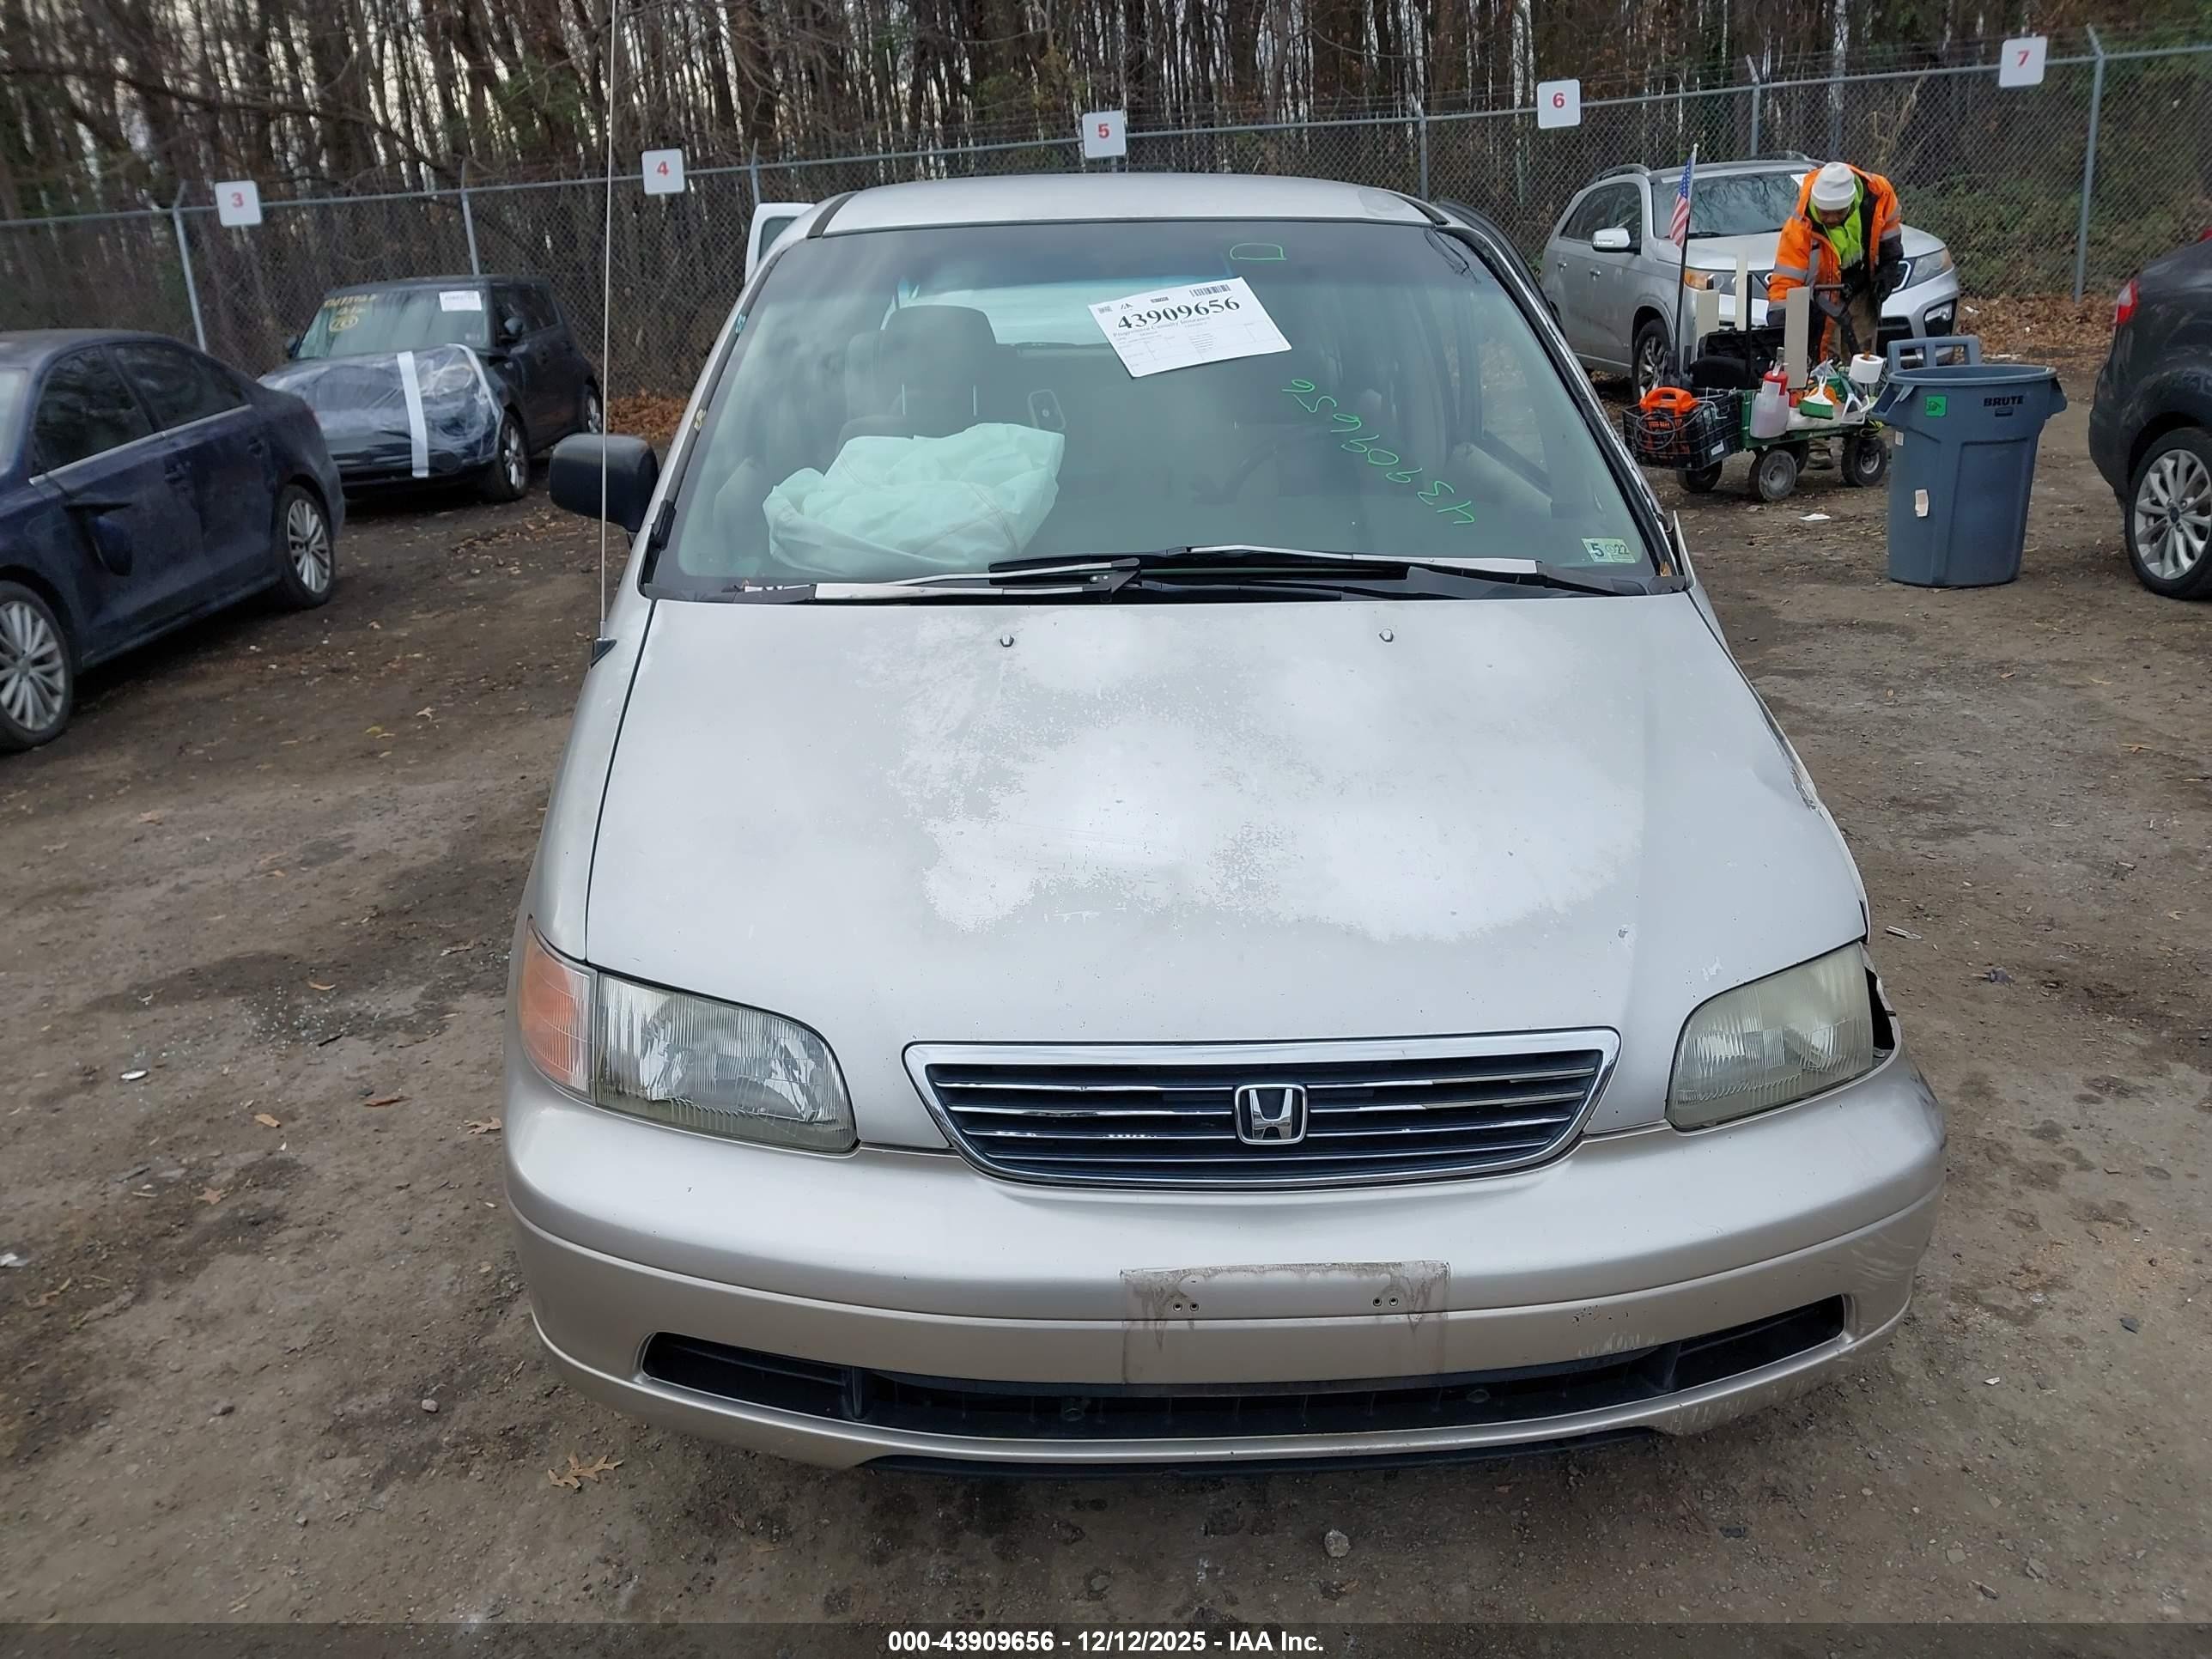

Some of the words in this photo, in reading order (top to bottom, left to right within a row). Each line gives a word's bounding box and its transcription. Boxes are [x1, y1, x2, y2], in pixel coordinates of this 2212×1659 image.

[2018, 50, 2030, 67] 7
[1553, 92, 1565, 109] 6
[1097, 123, 1109, 139] 5
[656, 160, 669, 175] 4
[231, 191, 244, 208] 3
[1117, 296, 1240, 329] 43909656
[1984, 396, 2023, 406] BRUTE
[1281, 379, 1476, 525] 43909656
[1591, 543, 1605, 557] 5
[1613, 544, 1630, 555] 22
